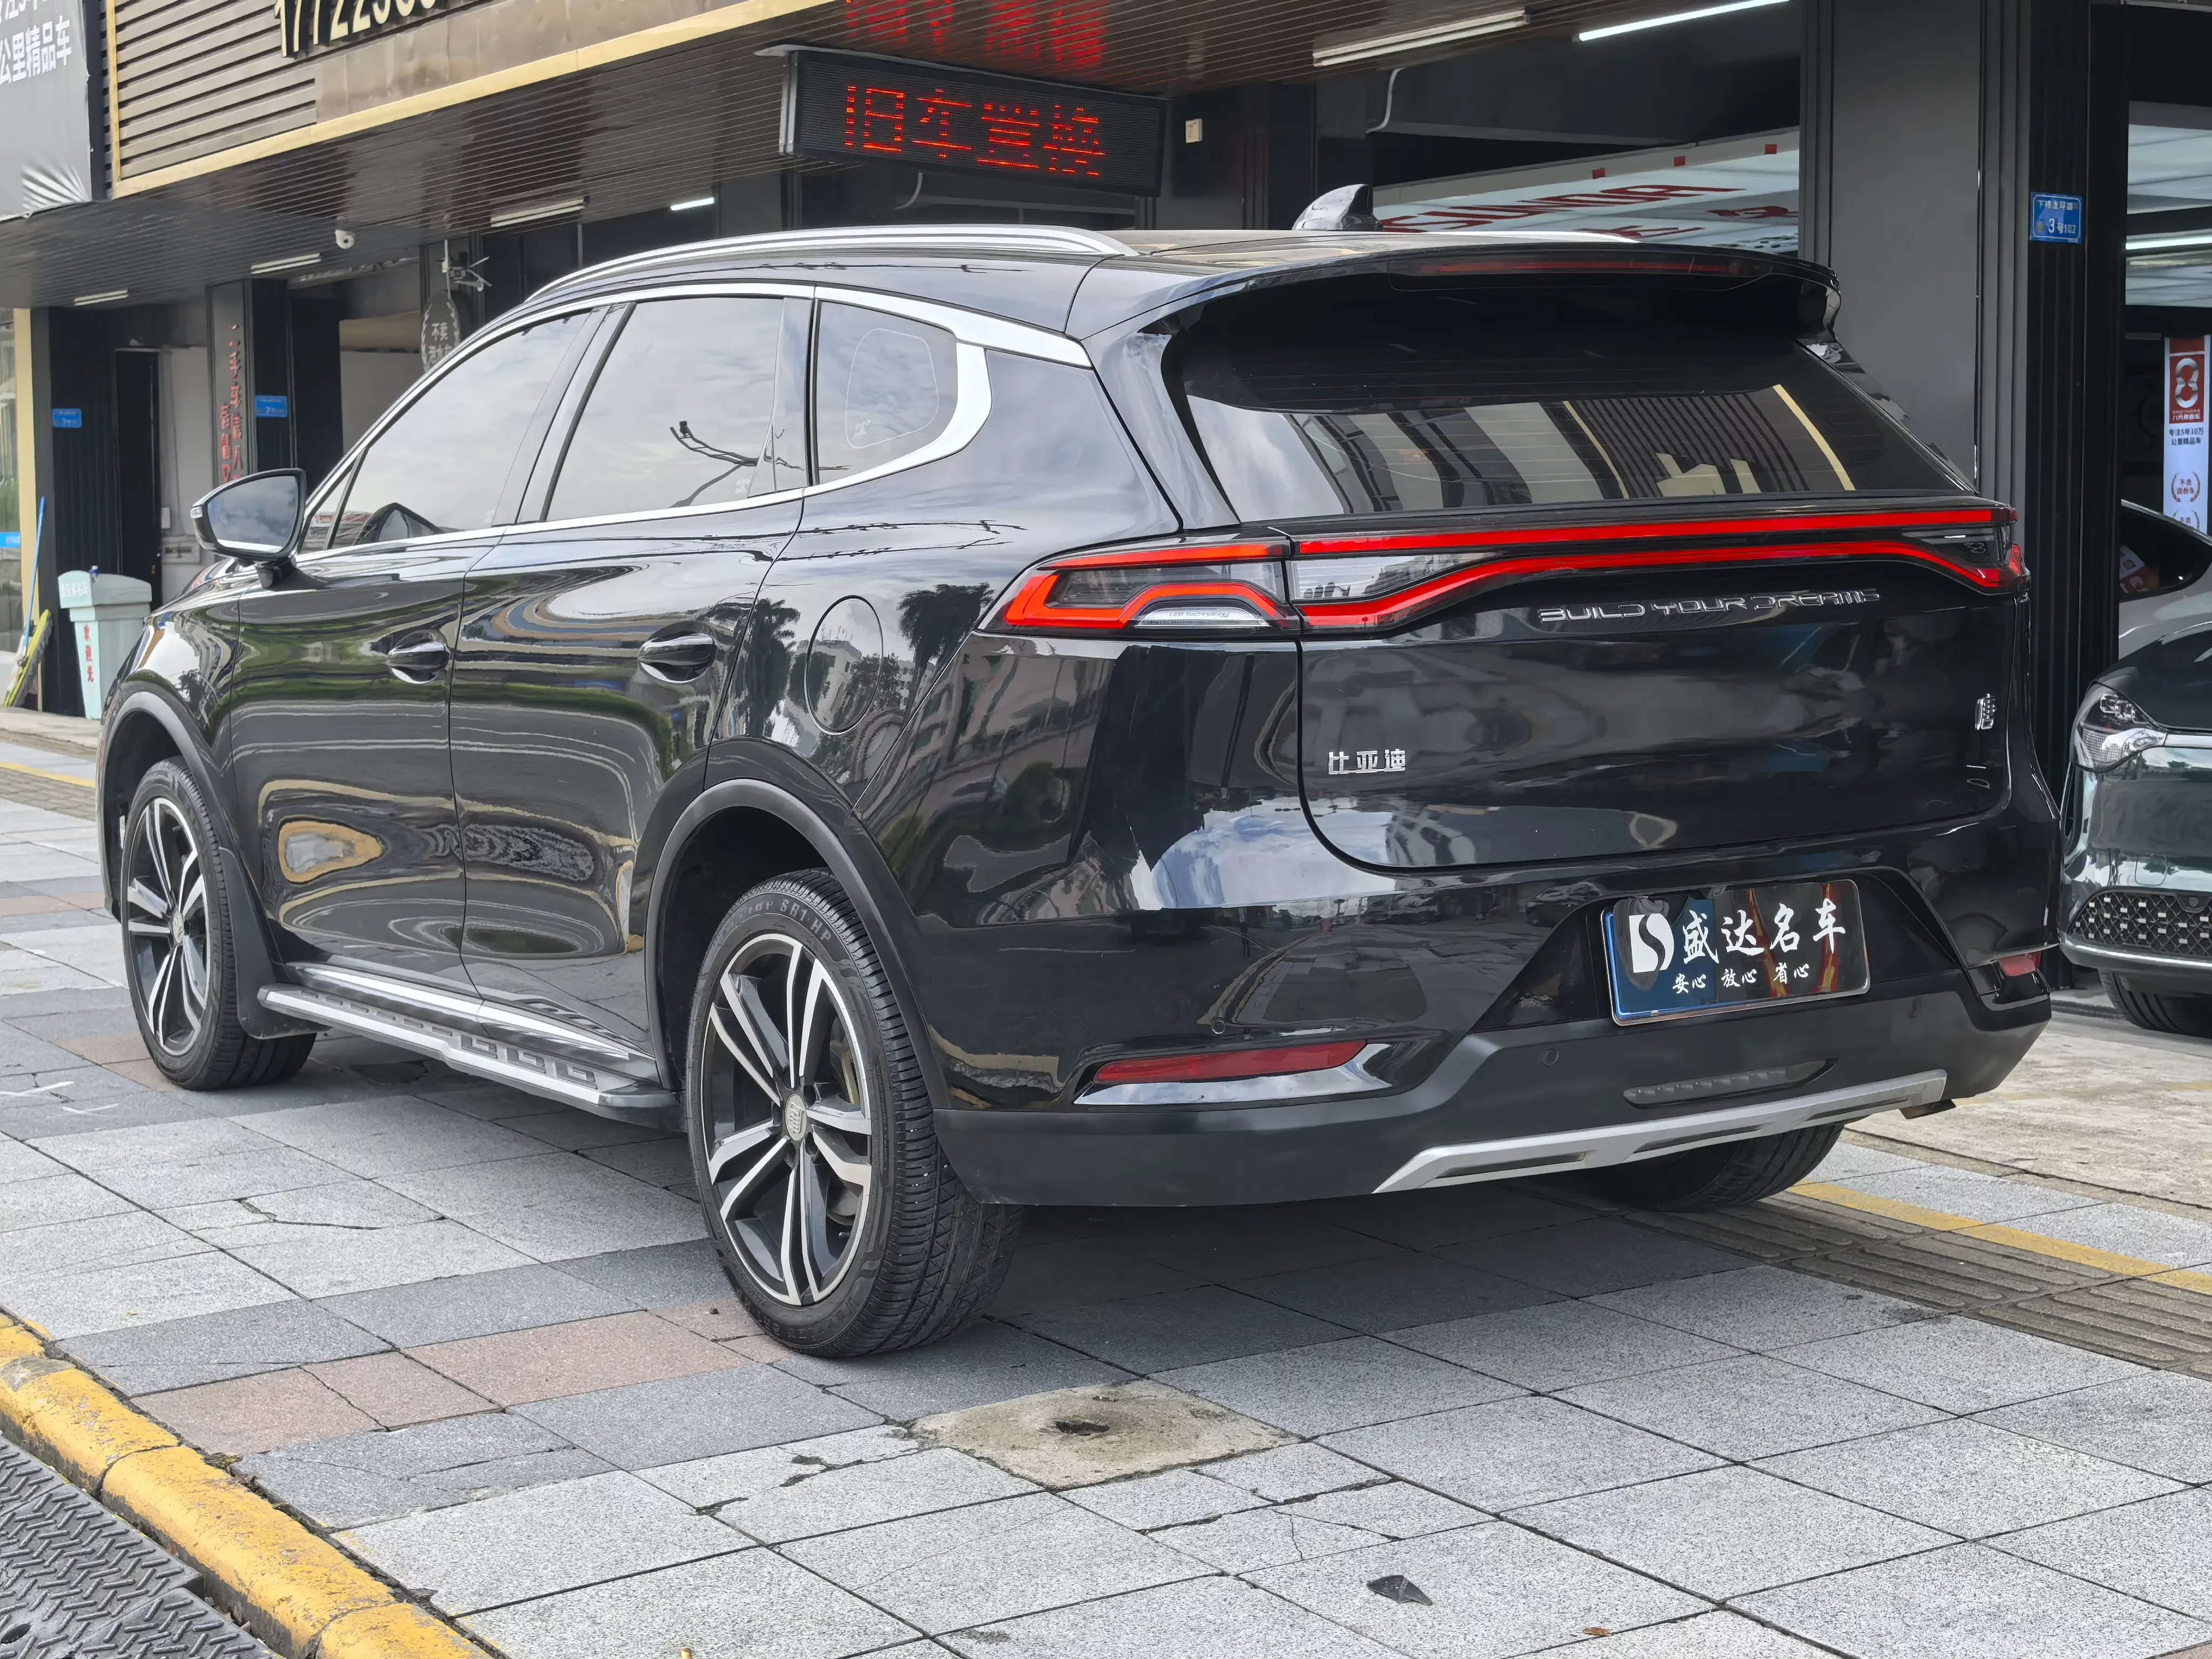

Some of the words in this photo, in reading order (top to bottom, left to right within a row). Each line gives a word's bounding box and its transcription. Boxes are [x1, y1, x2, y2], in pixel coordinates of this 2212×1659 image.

[0, 15, 71, 85] 公里精品车
[1537, 604, 1646, 623] BUILD
[1650, 597, 1748, 616] YOUR
[1750, 588, 1881, 610] DREAMS
[1328, 748, 1406, 774] 比亚迪
[1682, 898, 1846, 964] 盛达名车
[1673, 973, 1707, 994] 安心
[1721, 968, 1757, 988] 放心
[1773, 962, 1810, 984] 省心
